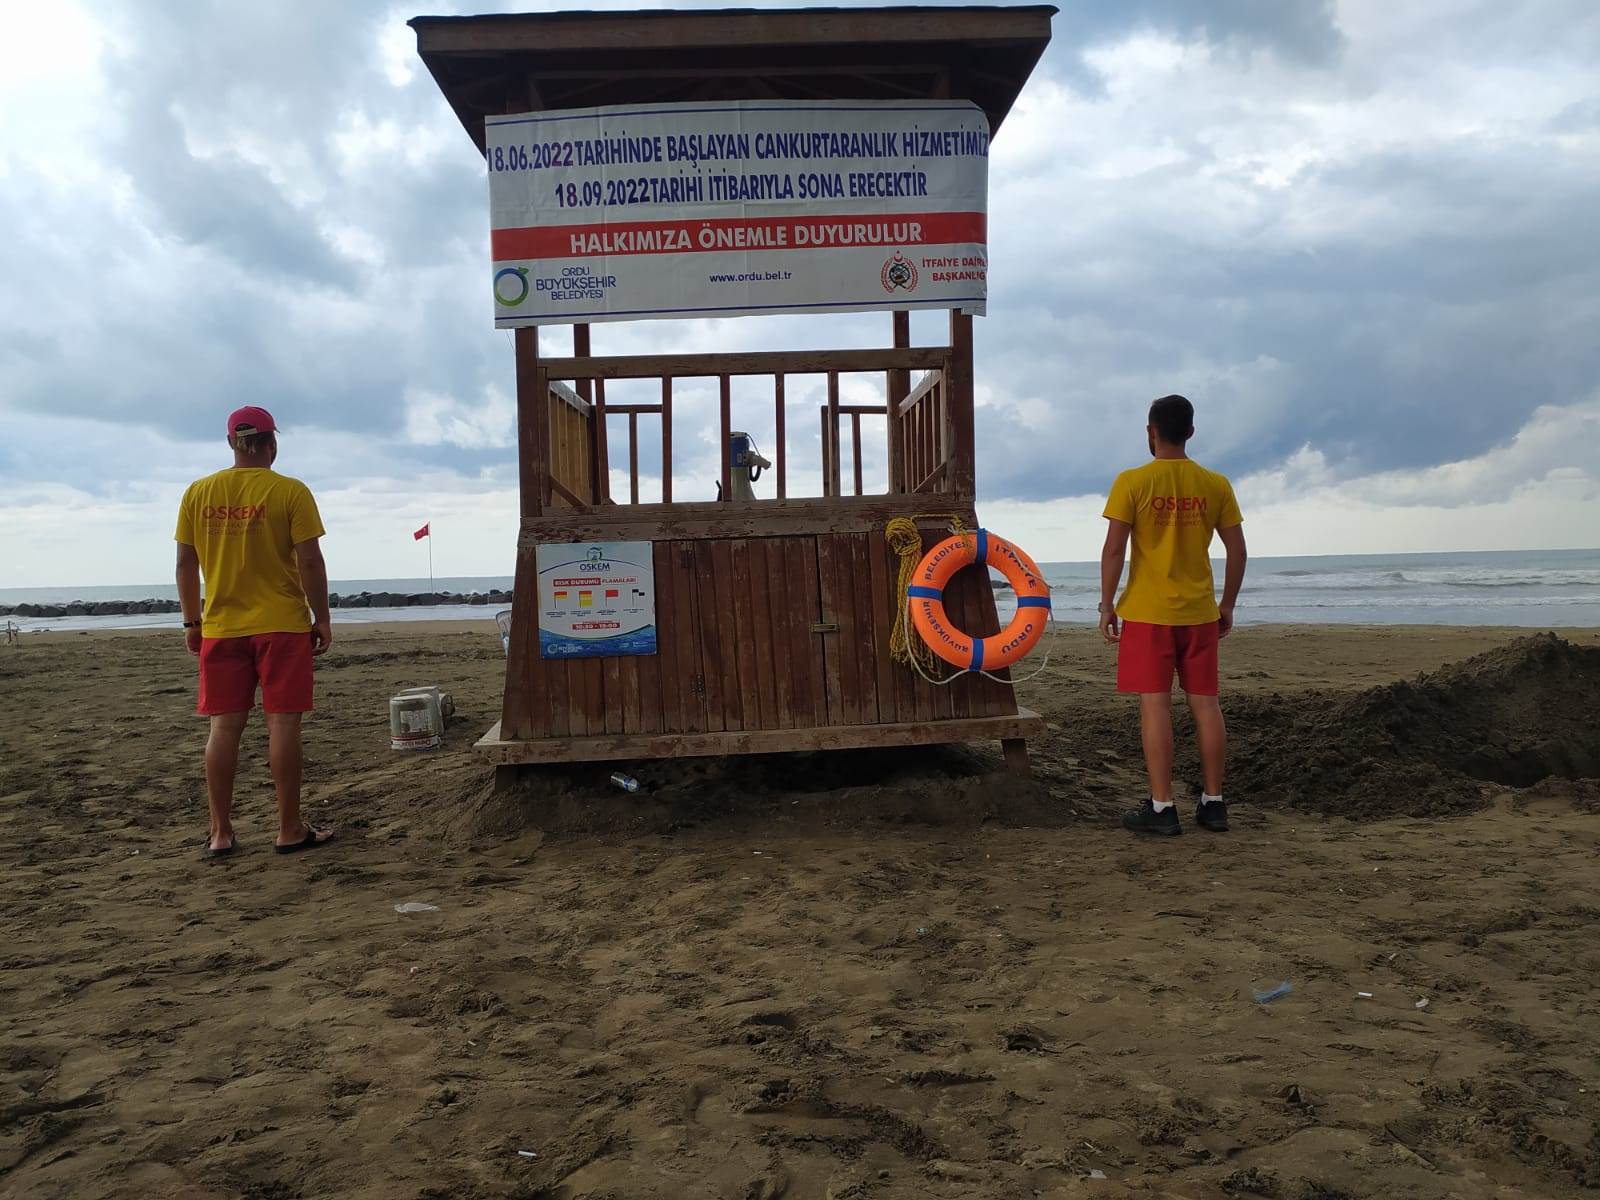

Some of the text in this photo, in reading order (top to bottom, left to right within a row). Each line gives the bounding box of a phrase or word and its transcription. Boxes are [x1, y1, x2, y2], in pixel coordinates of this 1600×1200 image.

[667, 133, 750, 168] BAŞLAYAN
[755, 132, 898, 159] CANKURTARANLIK
[903, 124, 989, 157] HİZMETİMİZ
[708, 168, 794, 200] İTİBARIYLA
[799, 173, 845, 199] SONA
[849, 165, 928, 197] ERECEKTİR
[570, 222, 922, 254] HALKIMIZA ÖNEMLE DUYURULUR
[922, 256, 959, 268] İTFAİYE
[561, 266, 590, 277] ORDU
[709, 270, 792, 283] www.ordu.bel.tr
[202, 503, 267, 520] OSKEM
[579, 562, 611, 571] OSKEM
[1001, 623, 1034, 655] ORDU
